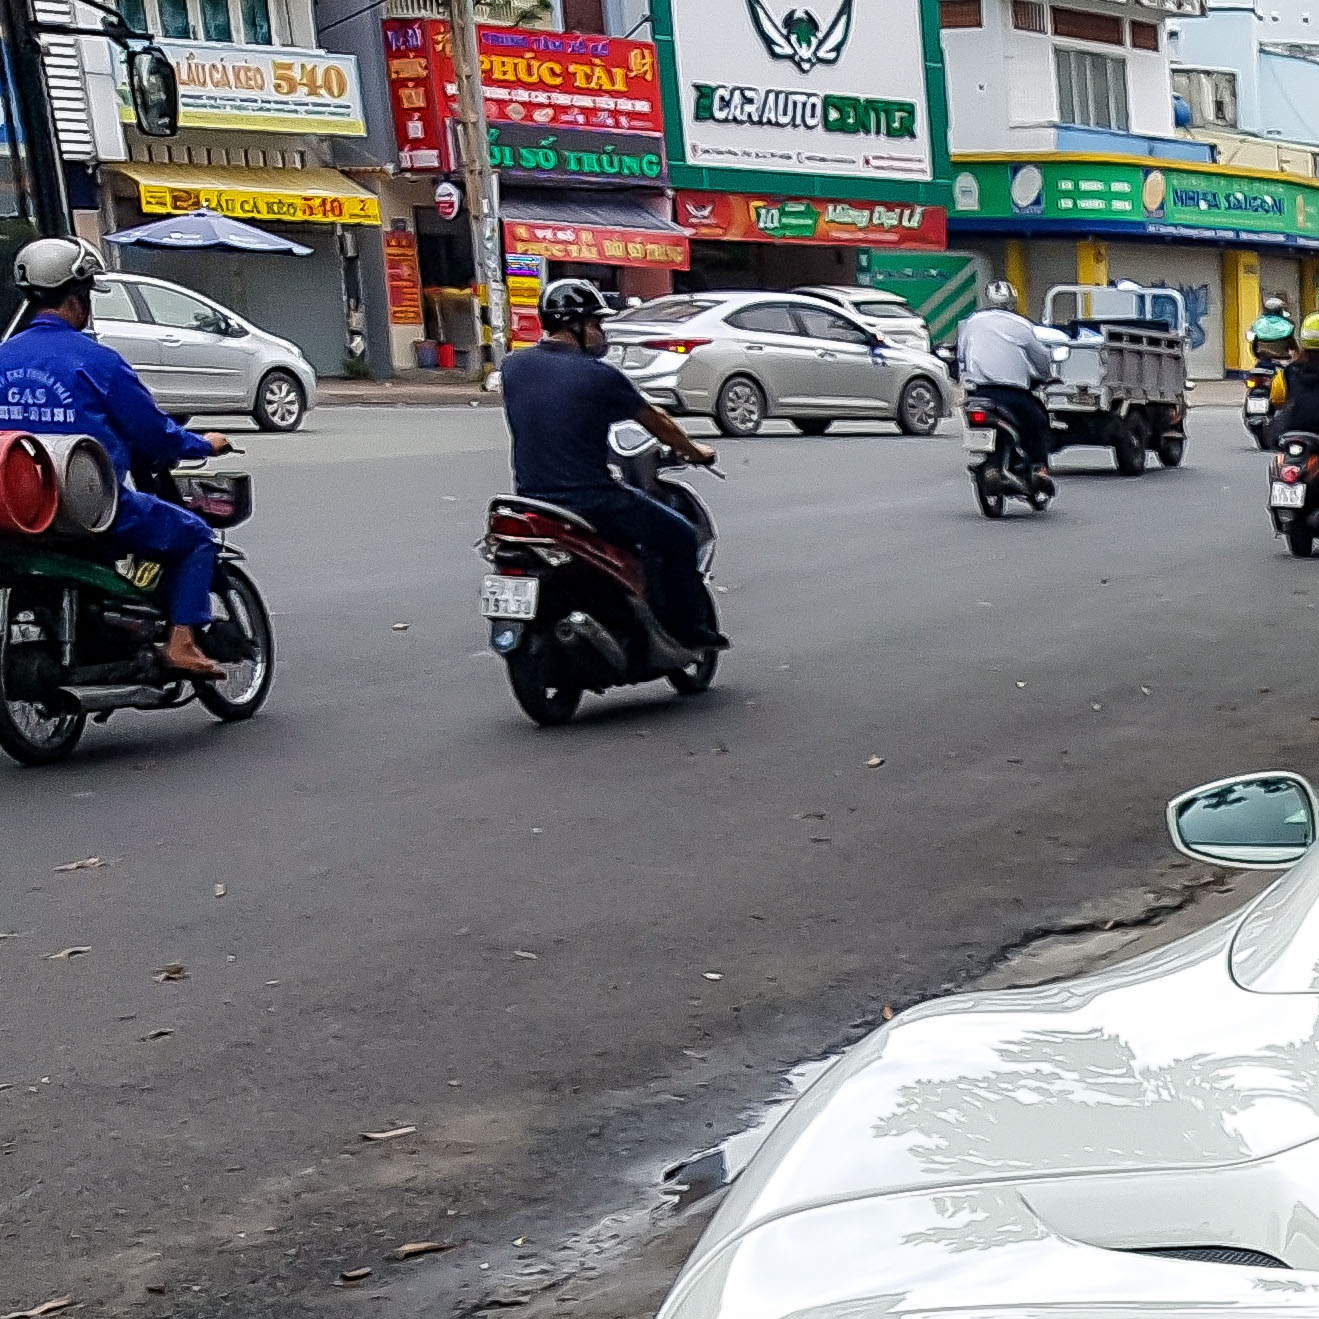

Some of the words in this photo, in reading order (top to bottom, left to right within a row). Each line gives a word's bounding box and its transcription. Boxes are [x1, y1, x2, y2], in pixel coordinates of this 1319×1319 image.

[272, 60, 349, 99] 540
[568, 57, 629, 92] TÀI
[519, 135, 559, 170] SỐ
[7, 387, 47, 405] GAS
